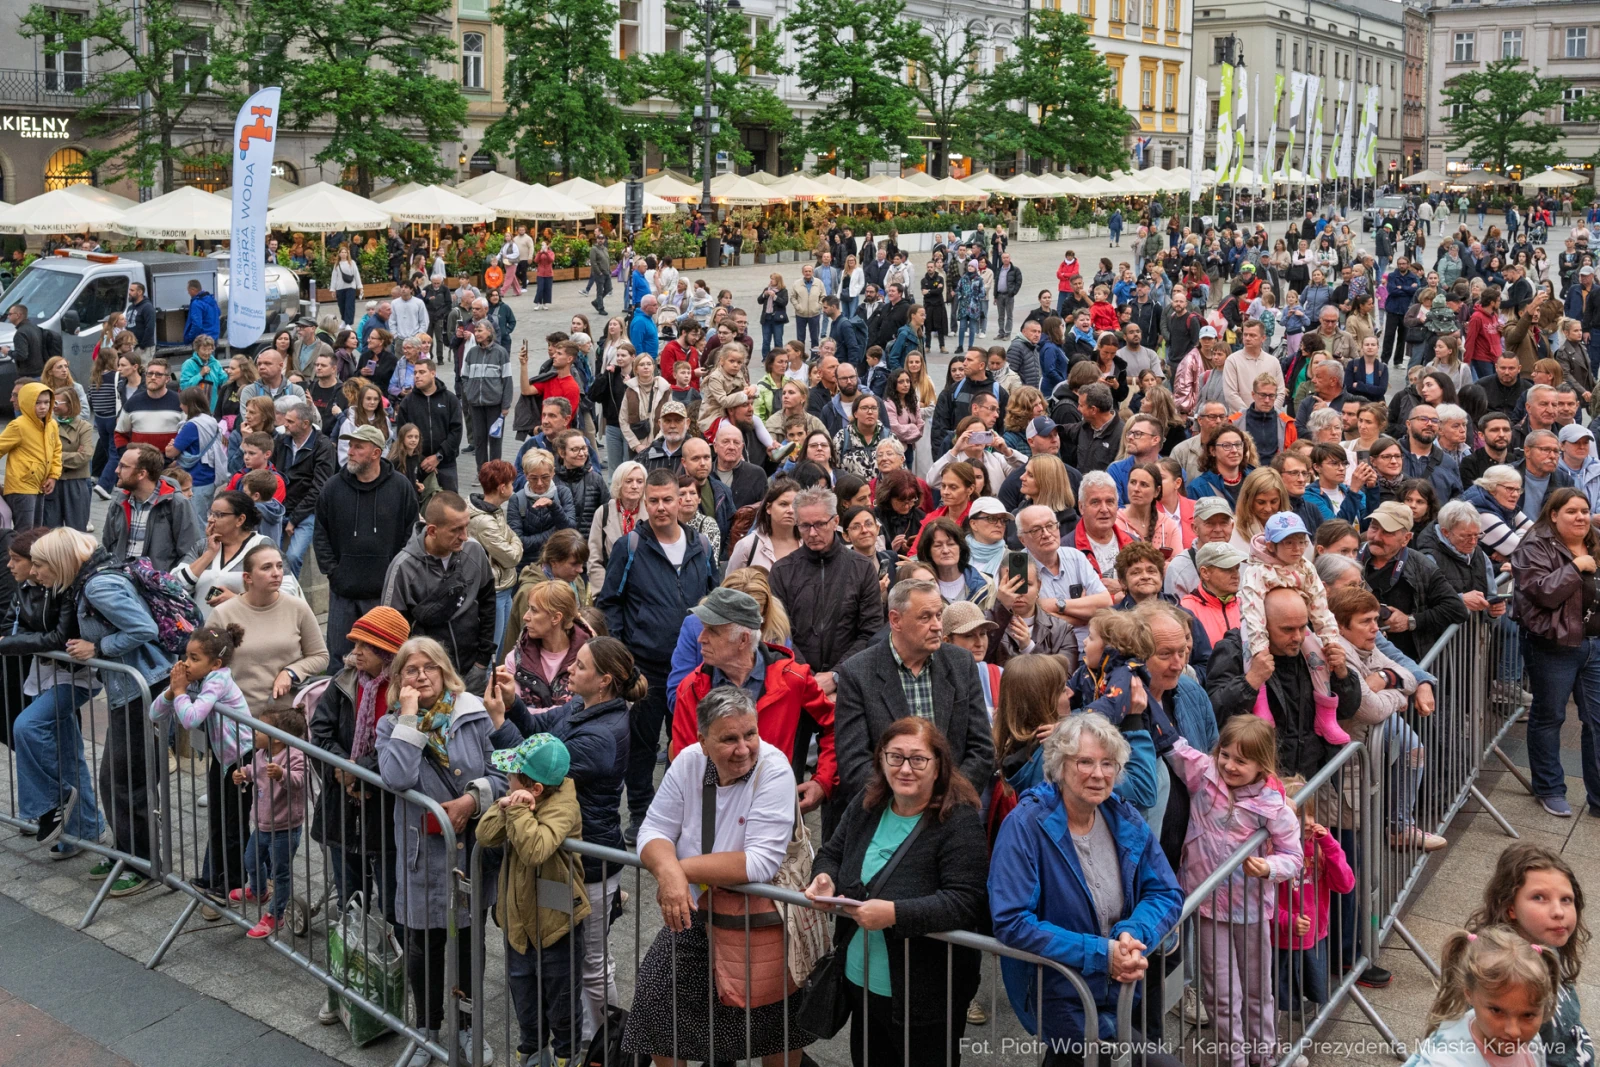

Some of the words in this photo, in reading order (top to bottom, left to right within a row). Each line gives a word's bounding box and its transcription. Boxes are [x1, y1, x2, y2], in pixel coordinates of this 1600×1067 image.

[0, 116, 69, 132] KIELNY
[43, 131, 70, 139] RESTO
[241, 162, 256, 220] WODA
[535, 212, 557, 220] OKOCIM
[33, 223, 79, 231] NAKIELNY
[297, 221, 338, 229] NAKIELNY
[161, 229, 187, 238] OKOCIM
